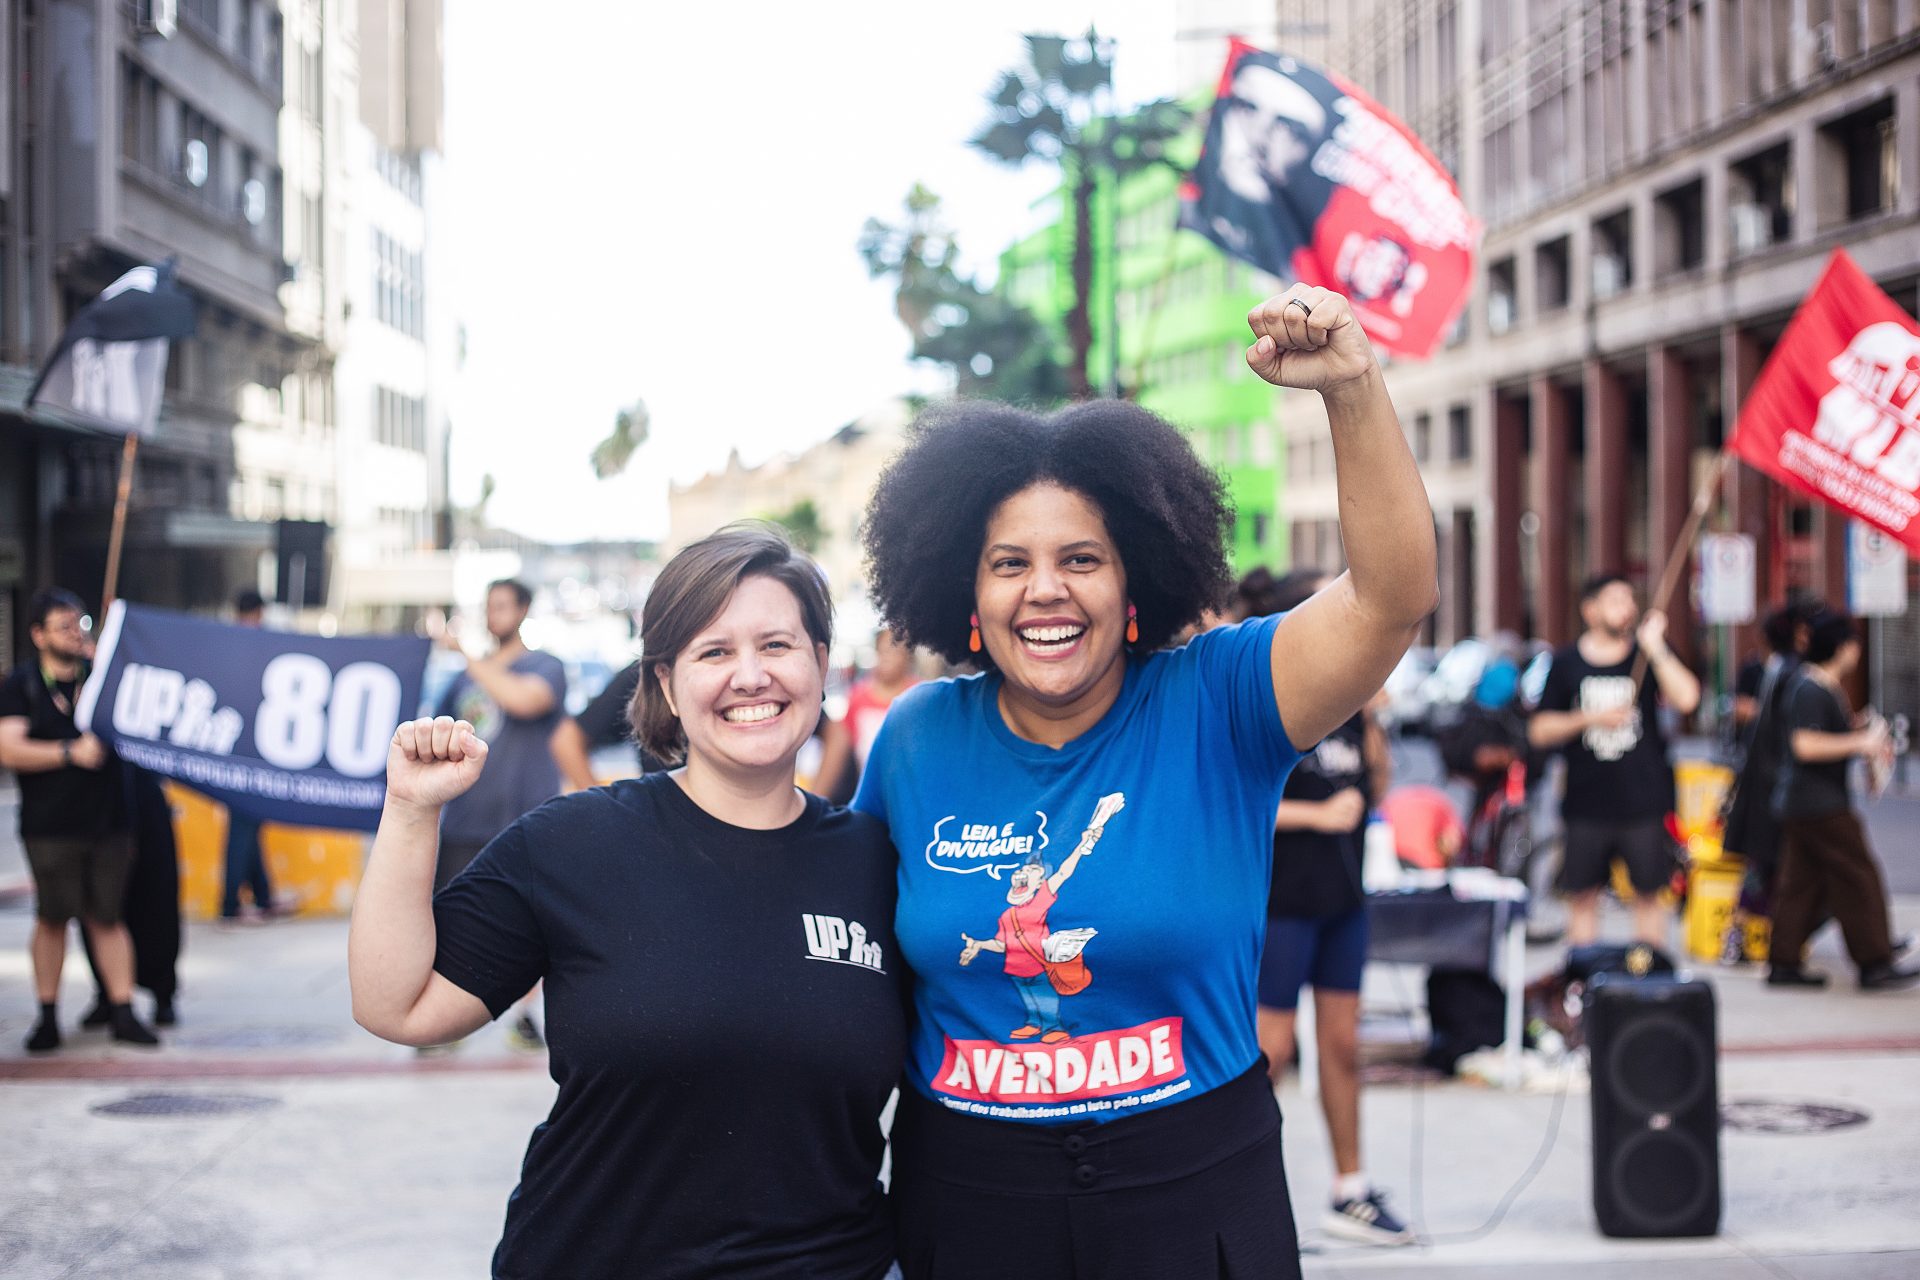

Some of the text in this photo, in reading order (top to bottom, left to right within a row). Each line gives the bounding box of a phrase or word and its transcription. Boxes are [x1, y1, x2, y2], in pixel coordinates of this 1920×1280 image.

[253, 652, 402, 778] 80
[961, 822, 1015, 841] LEIA E
[936, 835, 1034, 858] DIVULGUE!
[1113, 1095, 1140, 1110] pelo
